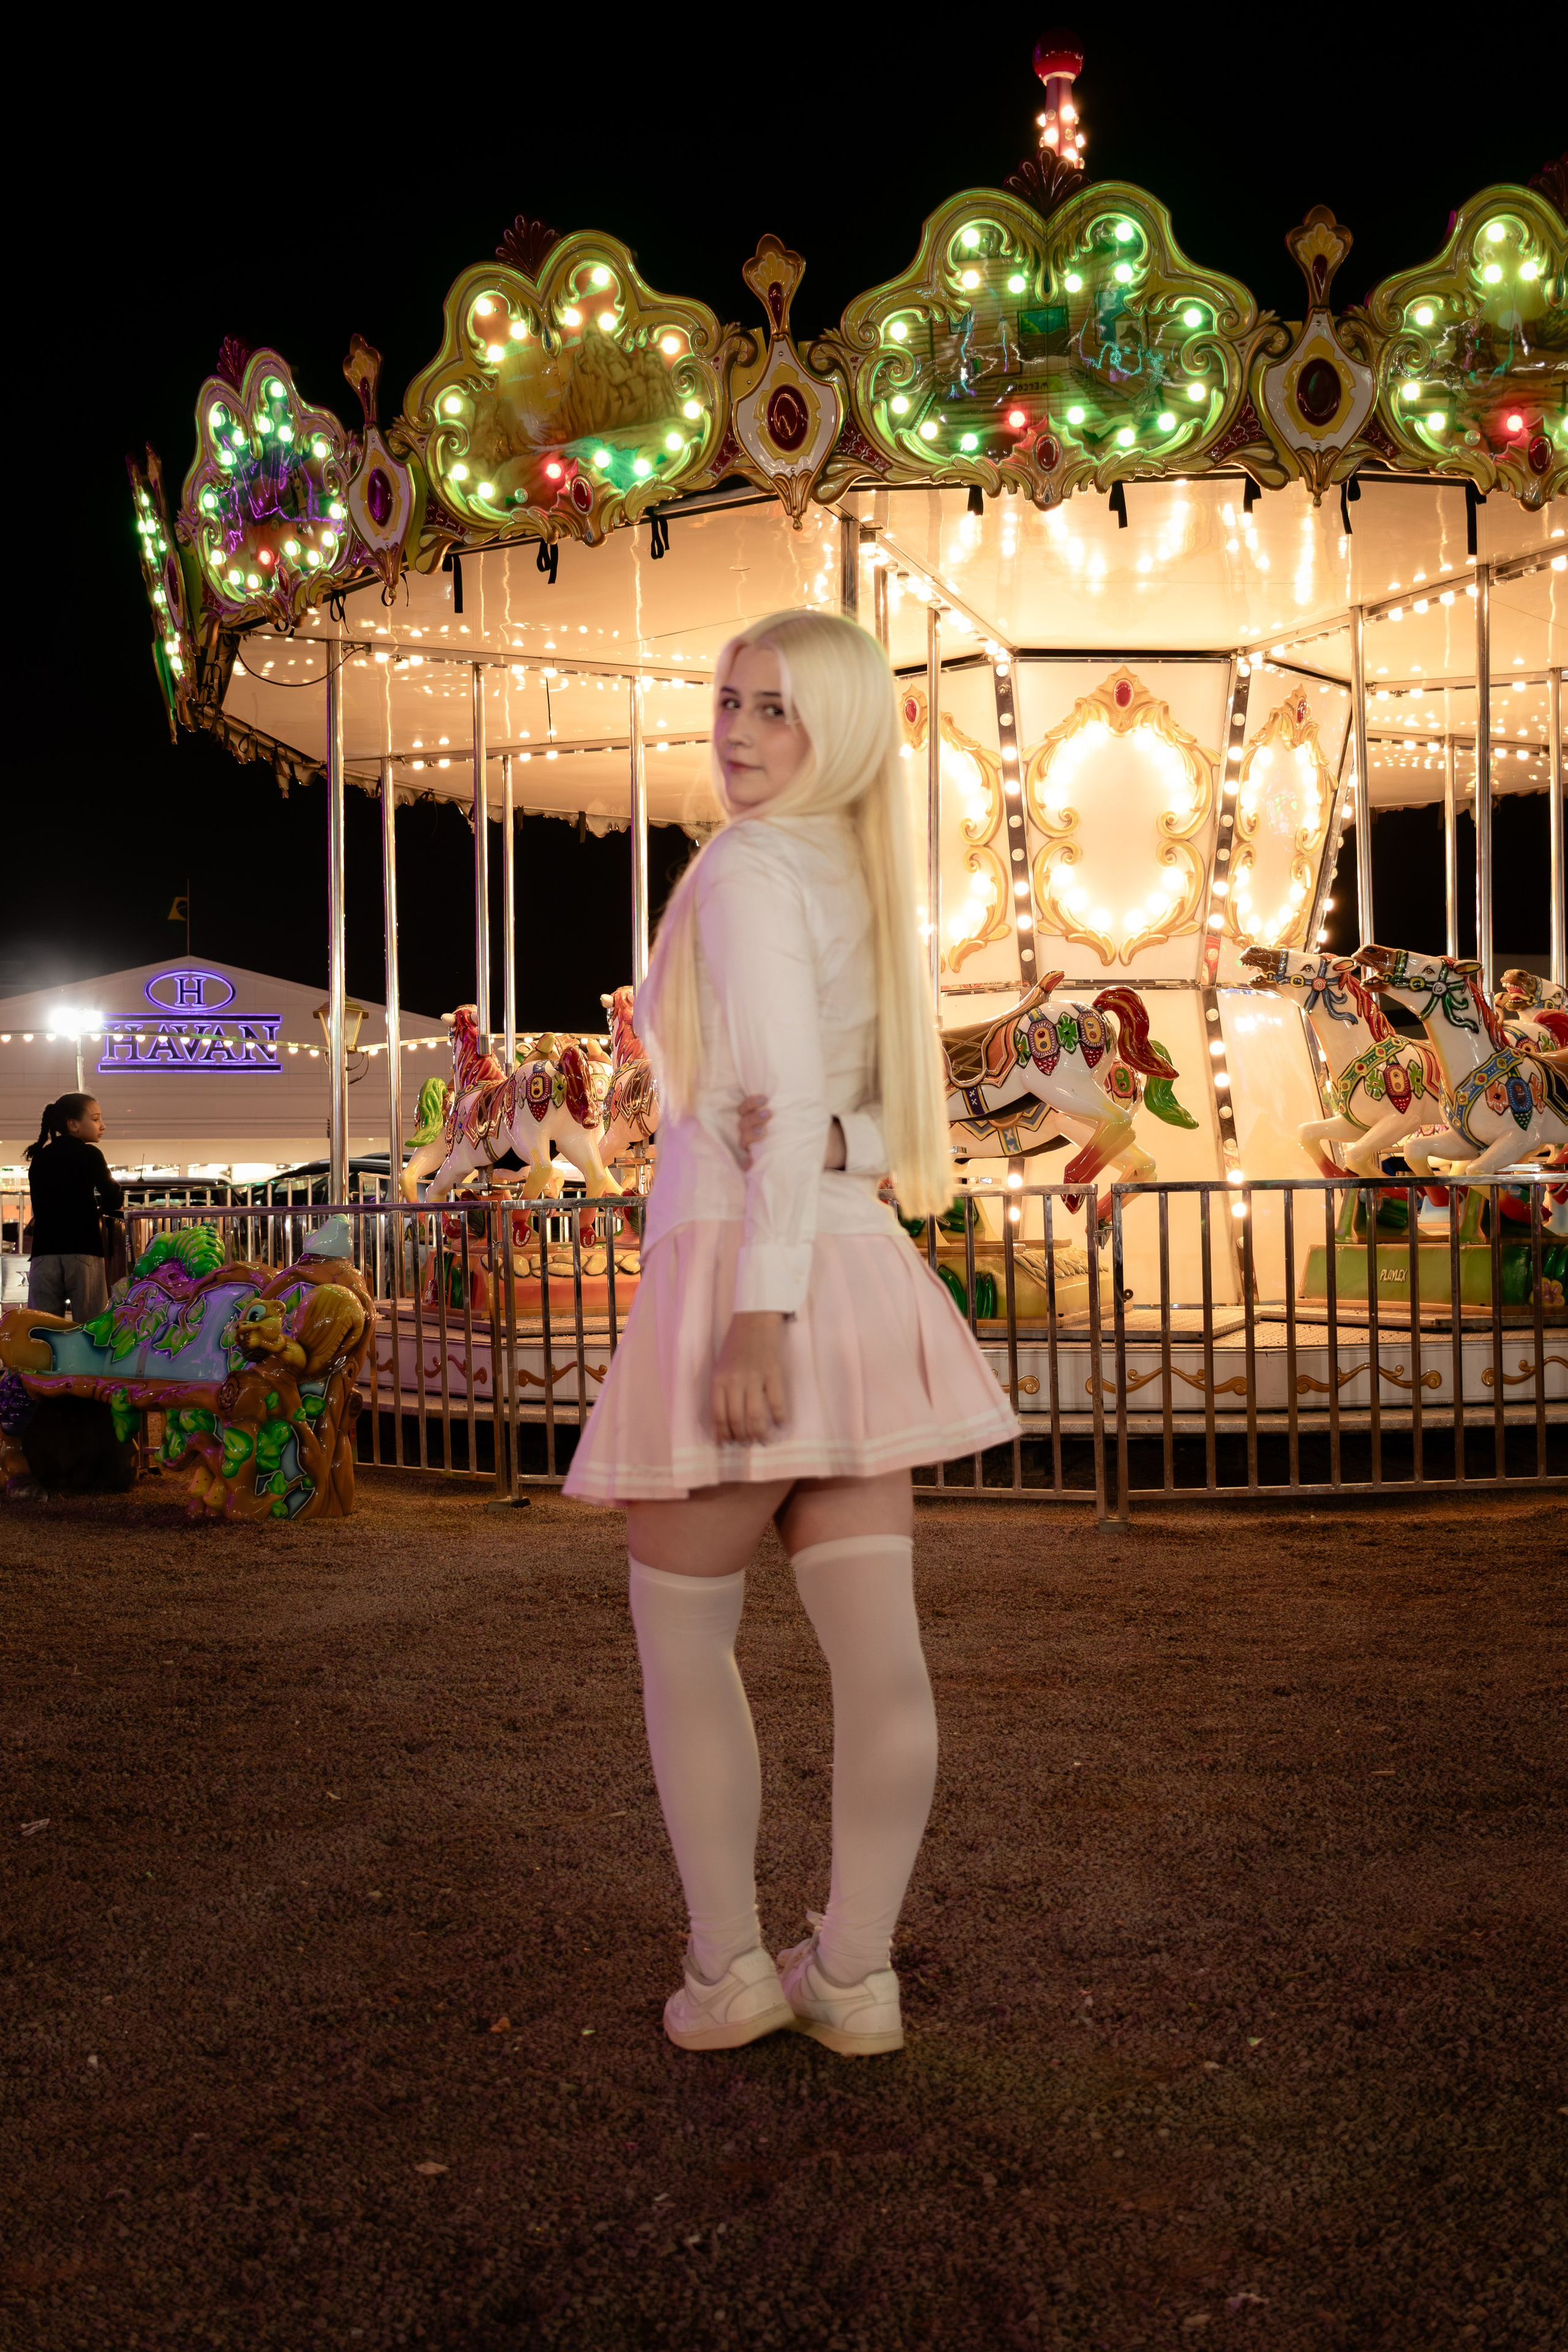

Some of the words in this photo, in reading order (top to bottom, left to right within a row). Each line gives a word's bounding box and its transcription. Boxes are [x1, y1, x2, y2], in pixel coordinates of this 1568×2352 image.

[1008, 382, 1049, 393] WELCO
[173, 976, 206, 1006] H
[101, 1023, 279, 1062] HAVAN
[1379, 1268, 1408, 1282] PLAYLEX
